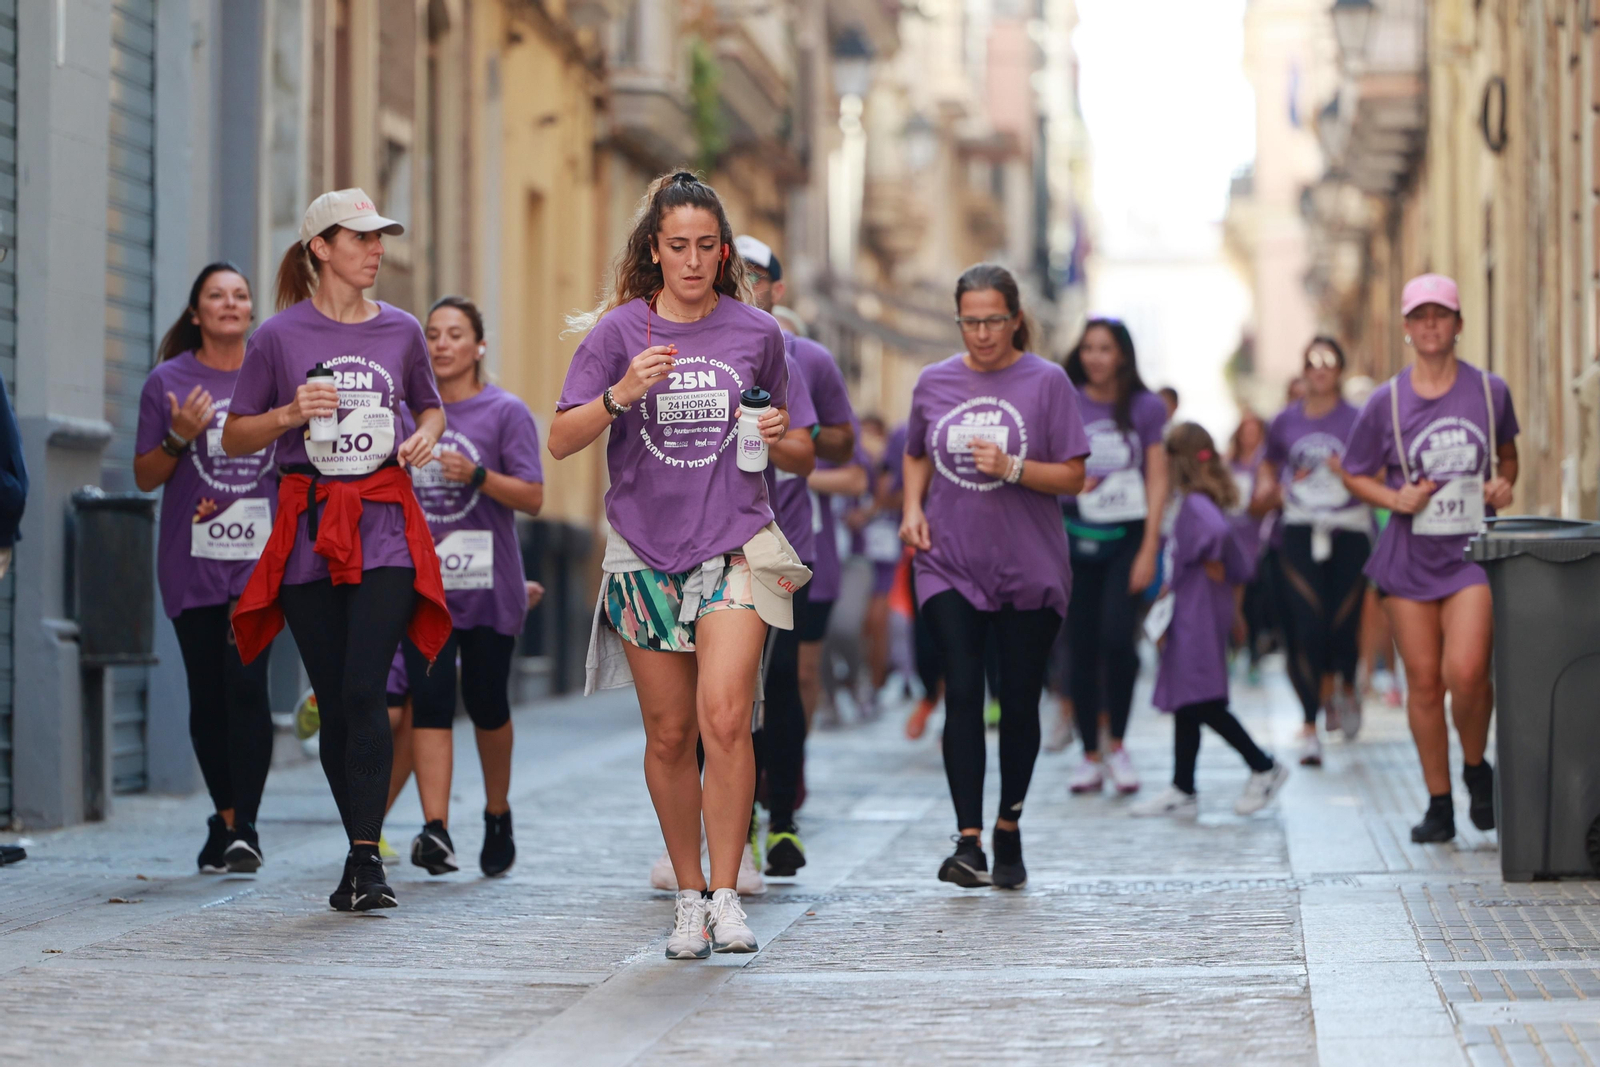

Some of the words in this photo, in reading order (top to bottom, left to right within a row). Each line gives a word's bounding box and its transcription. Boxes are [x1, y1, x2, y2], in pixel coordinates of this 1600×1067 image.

[333, 371, 373, 389] 25N
[667, 370, 717, 390] 25N
[709, 358, 744, 388] CONTRA
[368, 360, 395, 393] CONTRA
[389, 394, 396, 408] LA
[340, 399, 371, 408] HORAS
[667, 401, 680, 410] 24
[681, 399, 717, 409] HORAS
[660, 411, 683, 421] 900
[685, 410, 695, 419] 21
[697, 409, 708, 419] 21
[709, 408, 724, 418] 30
[959, 410, 1003, 426] 25N
[743, 439, 761, 447] 25N
[664, 456, 685, 469] LAS
[687, 453, 718, 469] HACIA
[1434, 499, 1465, 518] 391
[209, 522, 255, 540] 006
[436, 554, 474, 571] 07
